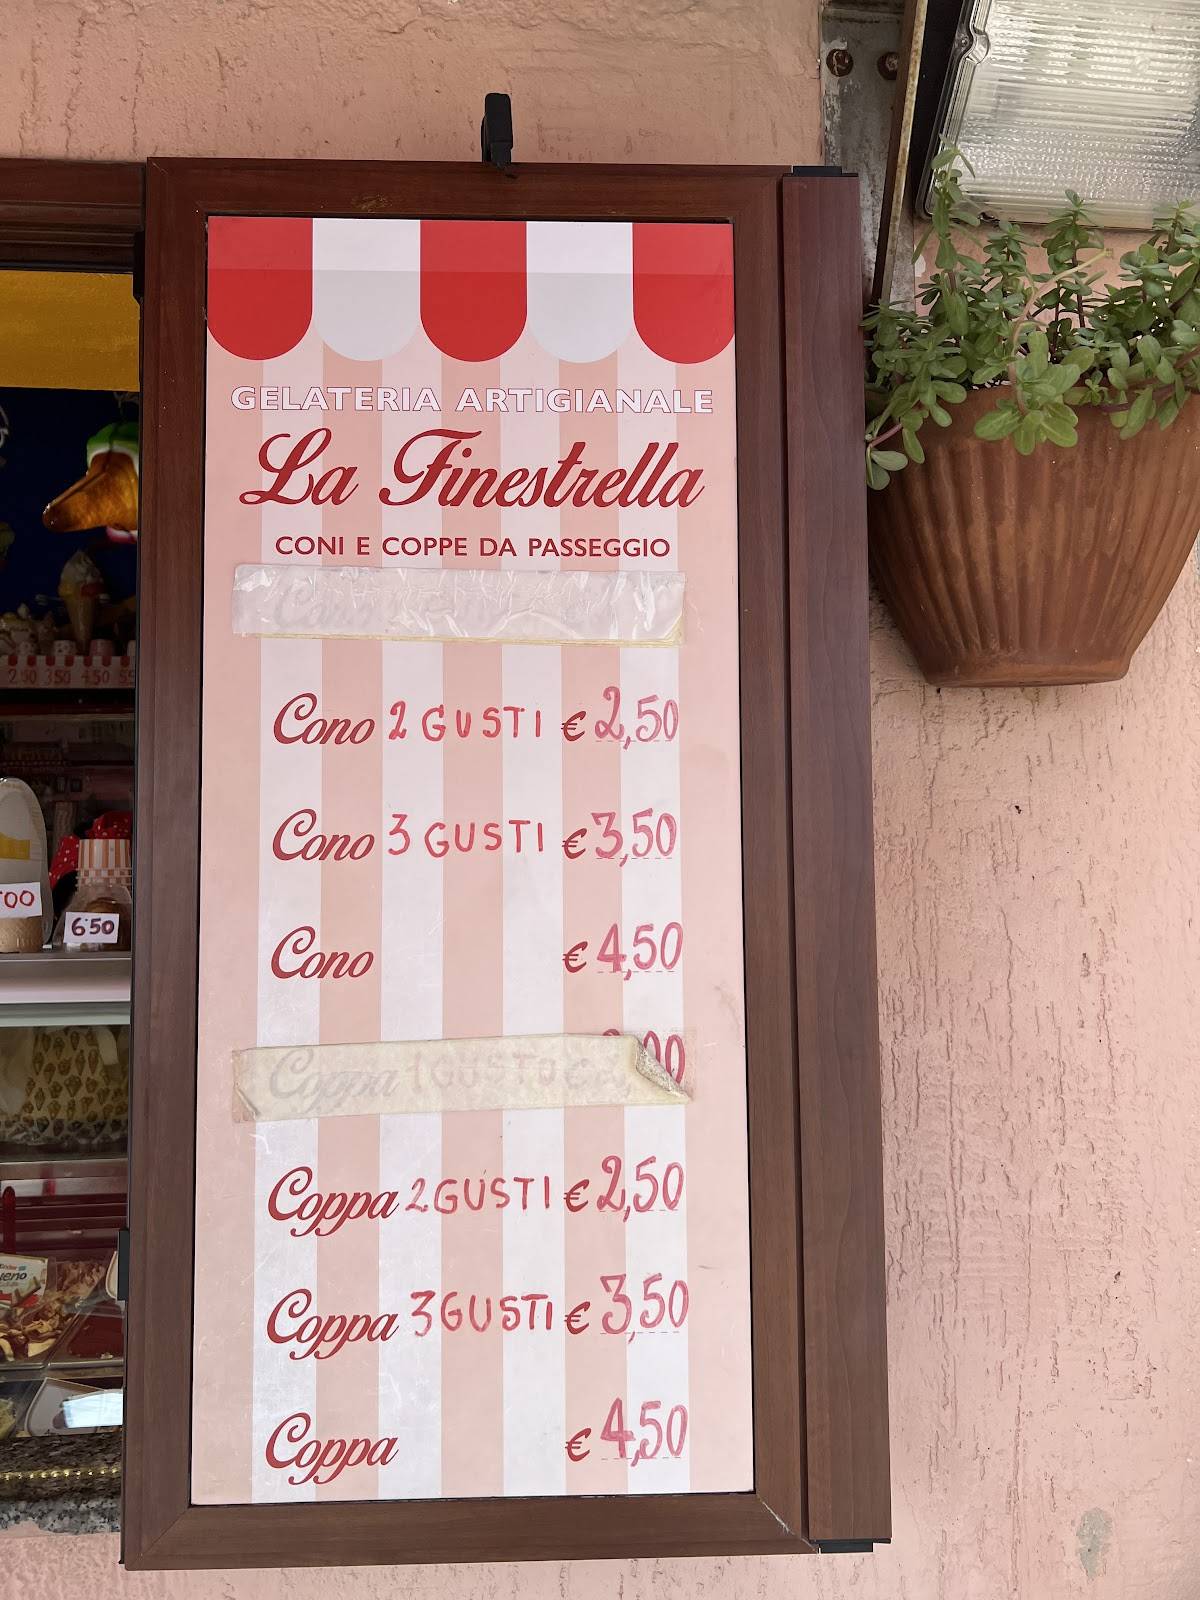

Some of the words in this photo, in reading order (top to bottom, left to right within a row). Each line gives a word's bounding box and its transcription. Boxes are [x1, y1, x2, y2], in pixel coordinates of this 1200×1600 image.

[231, 385, 441, 412] GELATERIA
[455, 386, 713, 414] ARTIGIANALE
[239, 427, 359, 506] La
[378, 428, 705, 508] Finestrella
[276, 536, 344, 556] CONI
[356, 536, 370, 556] E
[382, 536, 468, 557] COPPE
[480, 537, 517, 557] DA
[528, 538, 671, 558] PASSEGGIO
[273, 692, 376, 745] Cono
[421, 704, 542, 742] GUSTI
[272, 808, 375, 861] Cono
[424, 819, 545, 858] GUSTI
[0, 889, 35, 909] 00
[271, 926, 374, 979] Cono
[268, 1166, 399, 1238] Coppa
[266, 1288, 399, 1361] Coppa
[265, 1412, 399, 1486] Coppa
